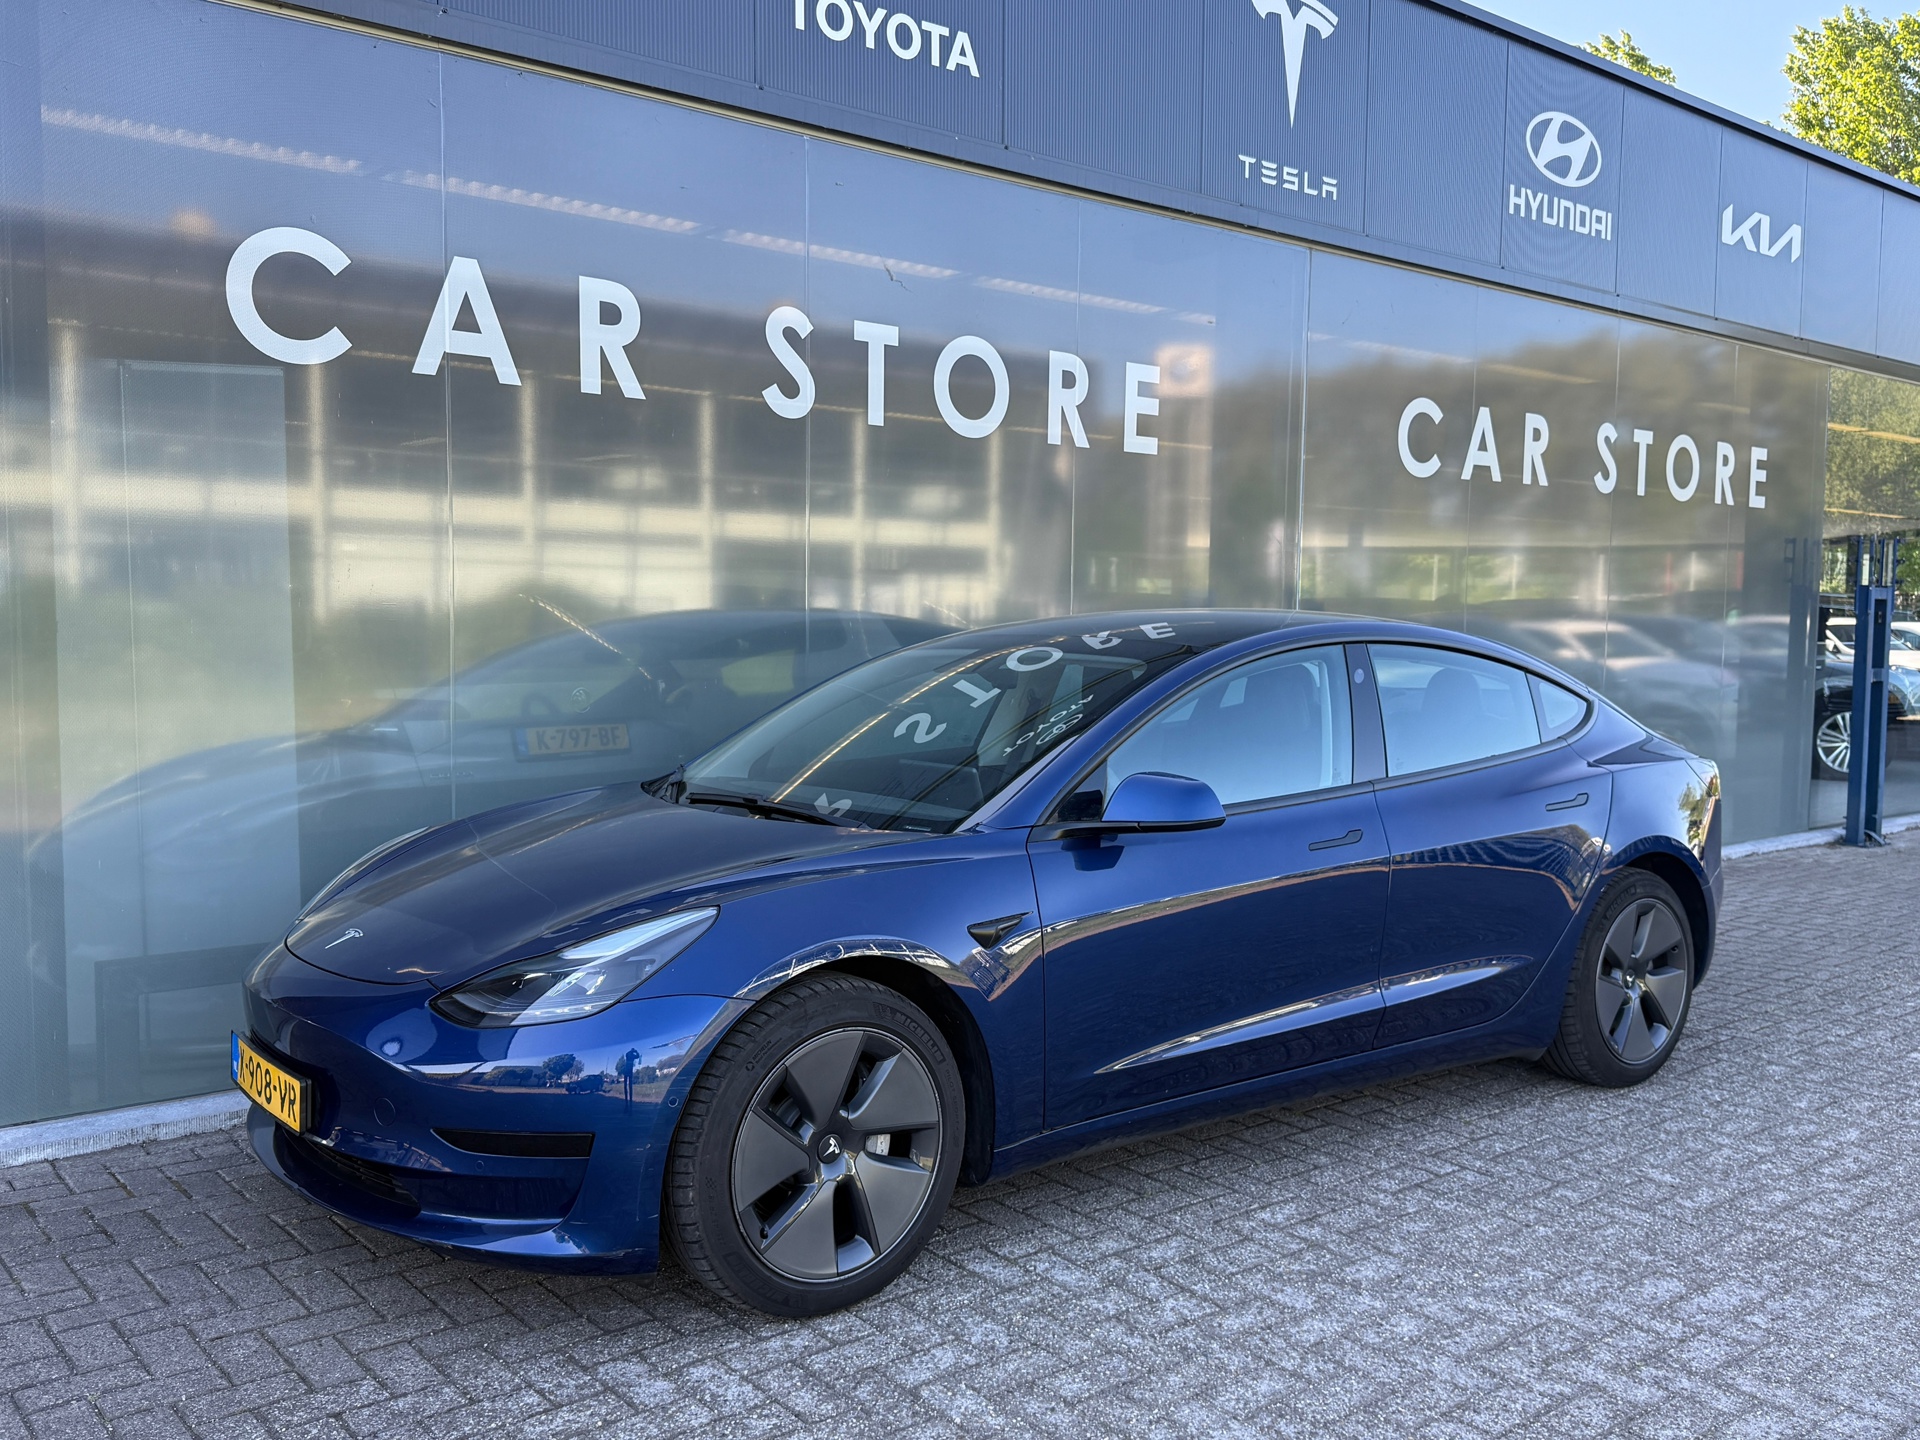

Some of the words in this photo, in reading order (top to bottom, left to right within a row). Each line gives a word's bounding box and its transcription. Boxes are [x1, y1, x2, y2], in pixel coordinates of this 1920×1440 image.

[1238, 154, 1338, 201] TESLA
[1509, 184, 1612, 241] HYUNDAI
[226, 226, 646, 400] CAR
[762, 306, 1161, 455] STORE
[1398, 397, 1549, 487] CAR
[1594, 422, 1768, 509] STORE
[535, 726, 620, 751] K-797-BF
[892, 1011, 945, 1063] MICHELIN
[239, 1045, 297, 1123] X-908-VR
